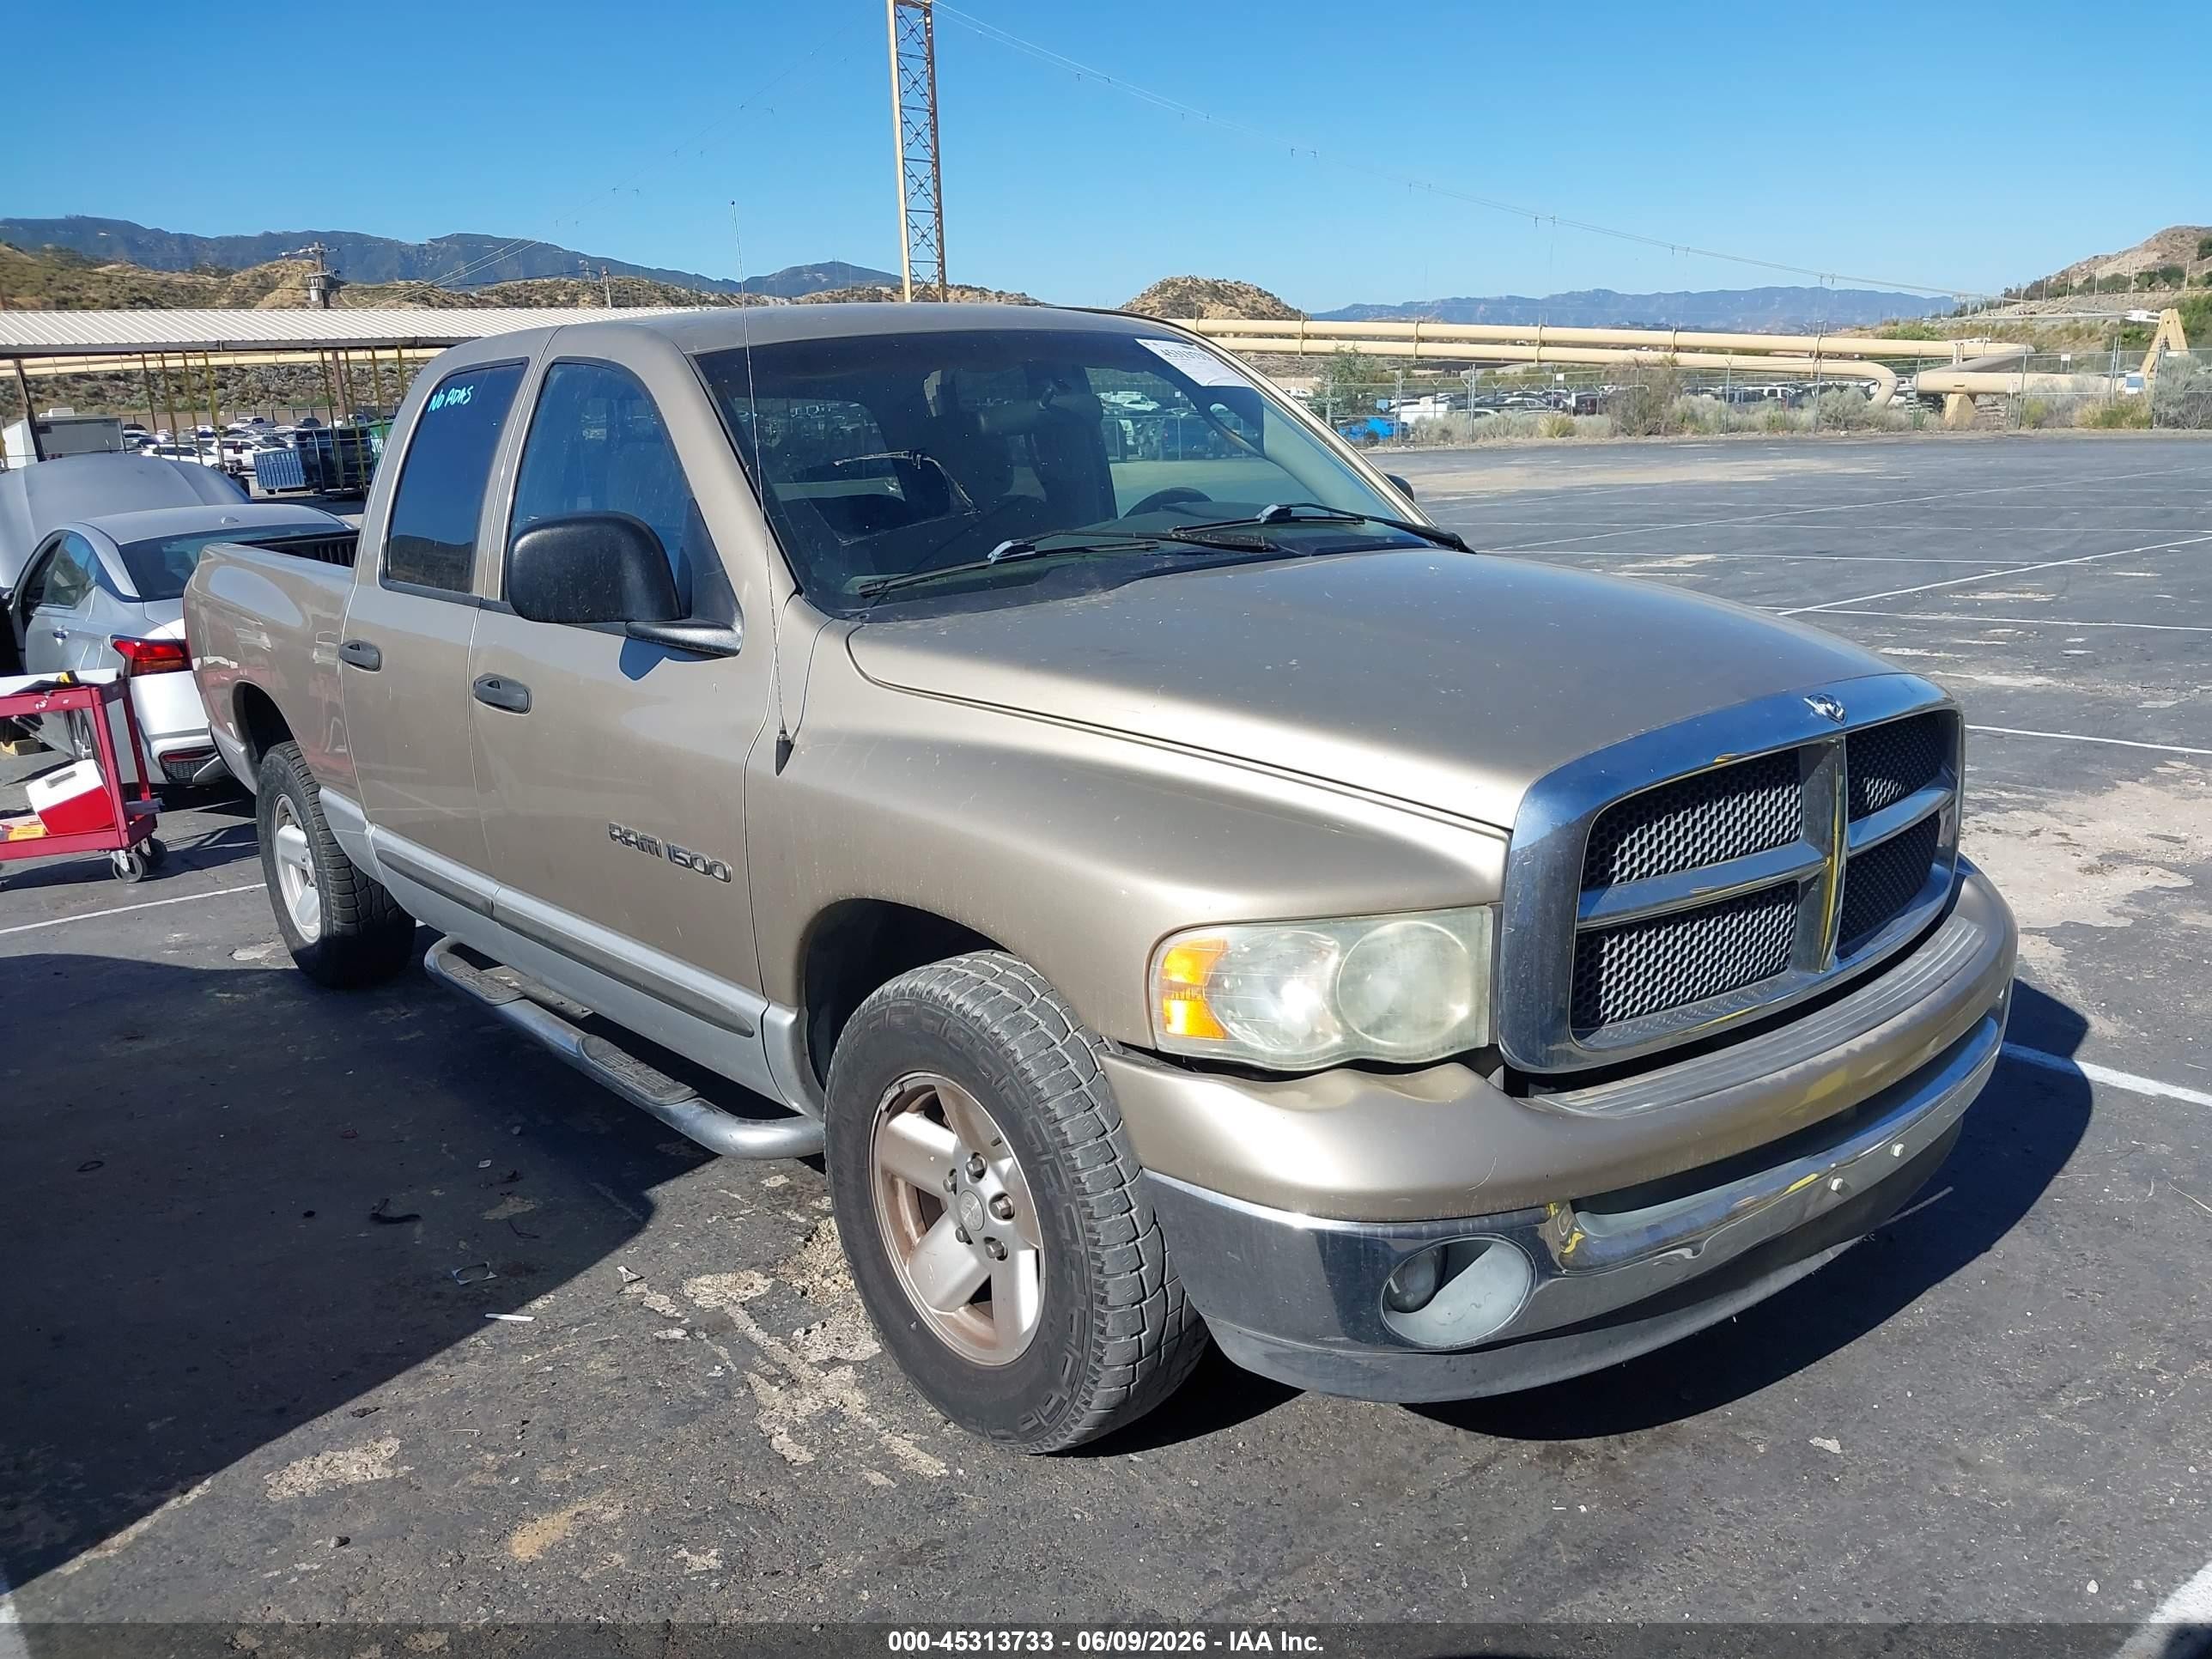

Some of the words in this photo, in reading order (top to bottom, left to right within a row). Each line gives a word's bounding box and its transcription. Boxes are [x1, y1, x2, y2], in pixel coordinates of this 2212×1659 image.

[445, 385, 474, 408] ADAS
[608, 821, 663, 859] RAM
[665, 841, 732, 884] 1500
